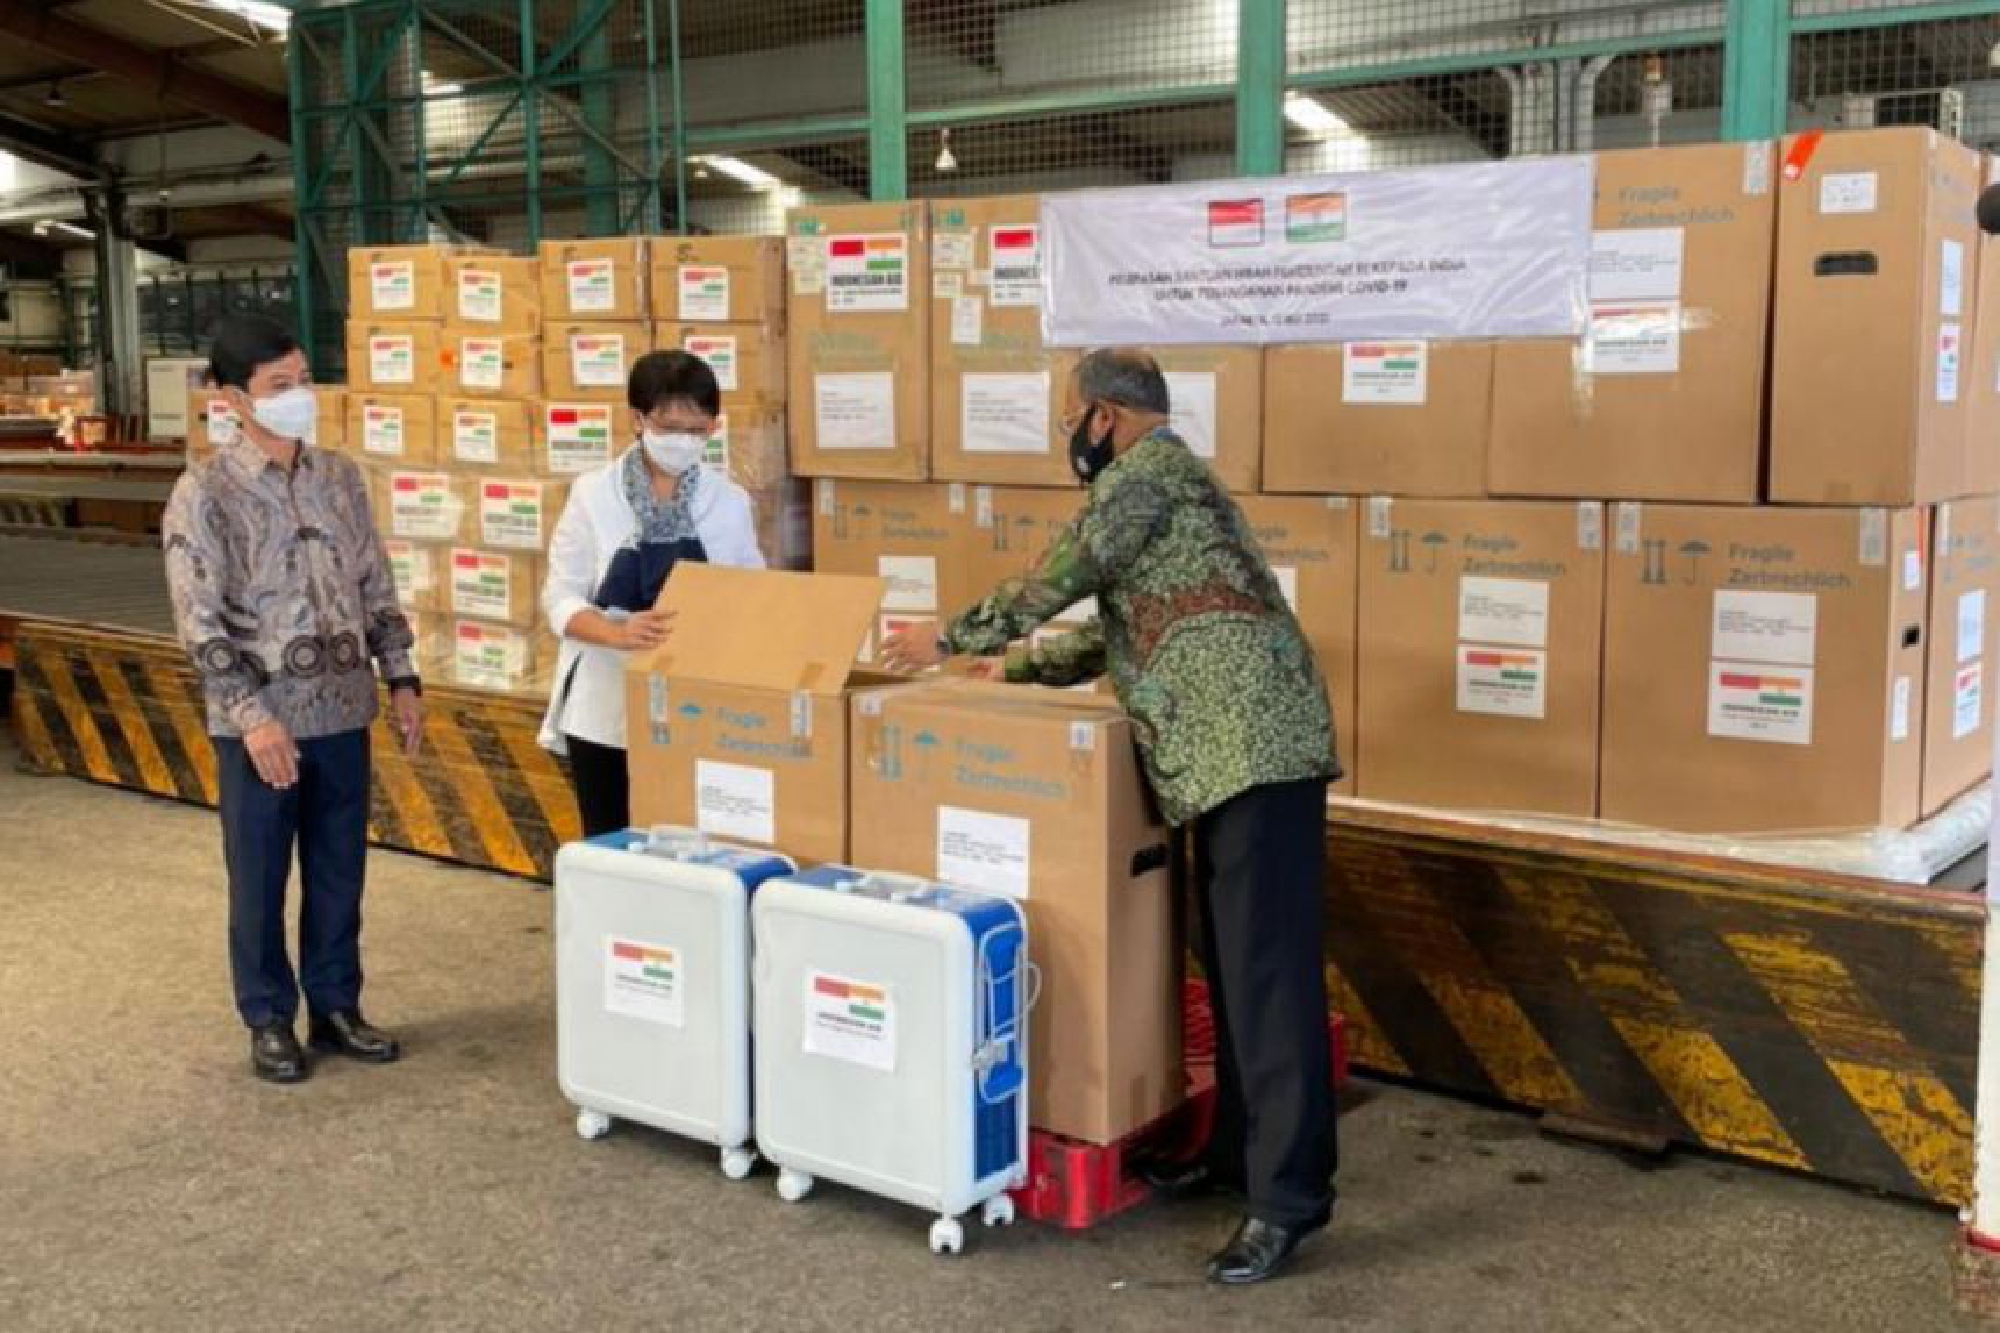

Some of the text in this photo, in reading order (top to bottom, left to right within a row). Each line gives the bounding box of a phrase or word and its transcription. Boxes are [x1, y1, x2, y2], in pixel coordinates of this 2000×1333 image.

[1463, 533, 1519, 555] Fragile
[1729, 542, 1795, 564] Fragile
[1729, 567, 1851, 589] Zerbrechlich
